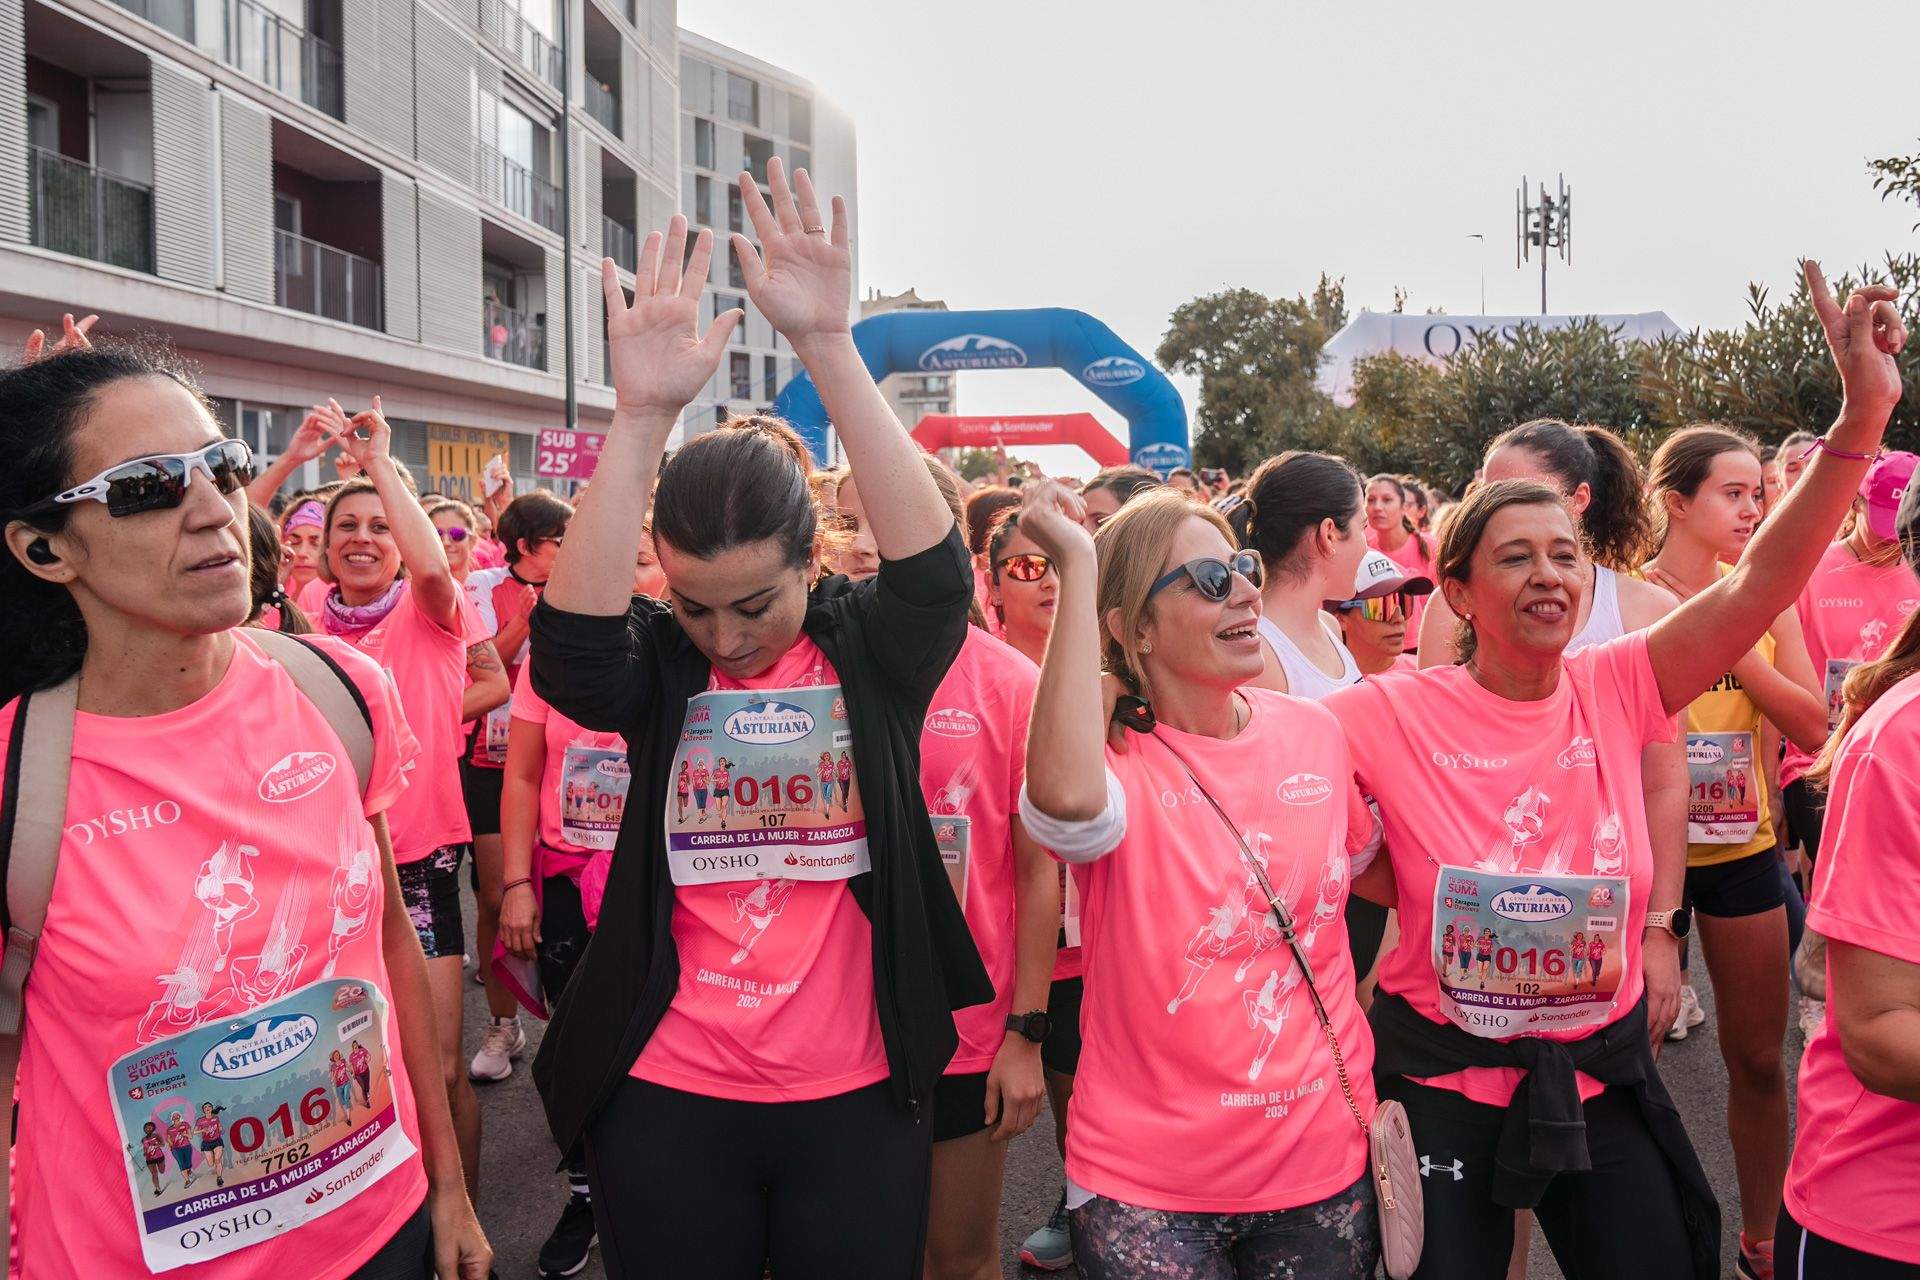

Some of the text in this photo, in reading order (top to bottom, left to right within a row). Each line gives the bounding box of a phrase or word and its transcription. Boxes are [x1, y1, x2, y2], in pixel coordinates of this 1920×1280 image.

[928, 355, 1018, 370] ASTURIANA
[1003, 420, 1054, 433] Santander
[541, 431, 577, 449] SUB
[538, 451, 578, 475] 25'
[1819, 597, 1864, 609] OYSHO
[729, 717, 810, 736] ASTURIANA
[928, 717, 978, 732] ASTURIANA
[1432, 751, 1509, 769] OYSHO
[266, 760, 332, 799] ASTURIANA
[733, 774, 814, 807] 016
[1282, 783, 1331, 801] ASTURIANA
[1689, 781, 1724, 800] 16
[597, 793, 624, 810] 01
[67, 800, 183, 845] OYSHO
[759, 813, 787, 828] 107
[573, 831, 604, 843] OYSHO
[690, 826, 855, 846] CARRERA DE LA MUJER ZARAGOZA
[692, 853, 760, 871] OYSHO
[799, 851, 856, 868] Santander
[1447, 884, 1479, 897] SUMA
[1593, 887, 1610, 900] 20
[1454, 898, 1480, 907] Zaragoza
[1496, 897, 1567, 914] ASTURIANA
[1495, 947, 1566, 976] 016
[696, 968, 741, 991] CARRERA
[743, 980, 758, 994] DE
[760, 983, 773, 996] LA
[1515, 983, 1540, 995] 102
[736, 994, 763, 1009] 2024
[1450, 991, 1597, 1007] CARRERA DE LA MUJER ZARAGOZA
[1453, 1006, 1509, 1028] OYSHO
[1540, 1008, 1591, 1022] Santander
[228, 1019, 309, 1054] CENTRAL LECHERA
[140, 1048, 178, 1066] DORSAL
[211, 1026, 314, 1075] ASTURIANA
[128, 1057, 180, 1083] SUMA
[145, 1072, 187, 1091] Zaragoza
[147, 1081, 188, 1098] DEPORTE
[1220, 1077, 1325, 1107] CARRERA DE LA MUJER
[229, 1087, 331, 1154] 016
[1264, 1105, 1289, 1118] 2024
[261, 1142, 311, 1175] 7762
[174, 1190, 238, 1219] CARRERA
[240, 1186, 259, 1200] DE
[260, 1178, 278, 1194] LA
[281, 1158, 323, 1187] MUJER
[331, 1121, 381, 1160] ZARAGOZA
[325, 1147, 385, 1197] Santander
[180, 1207, 273, 1250] OYSHO
